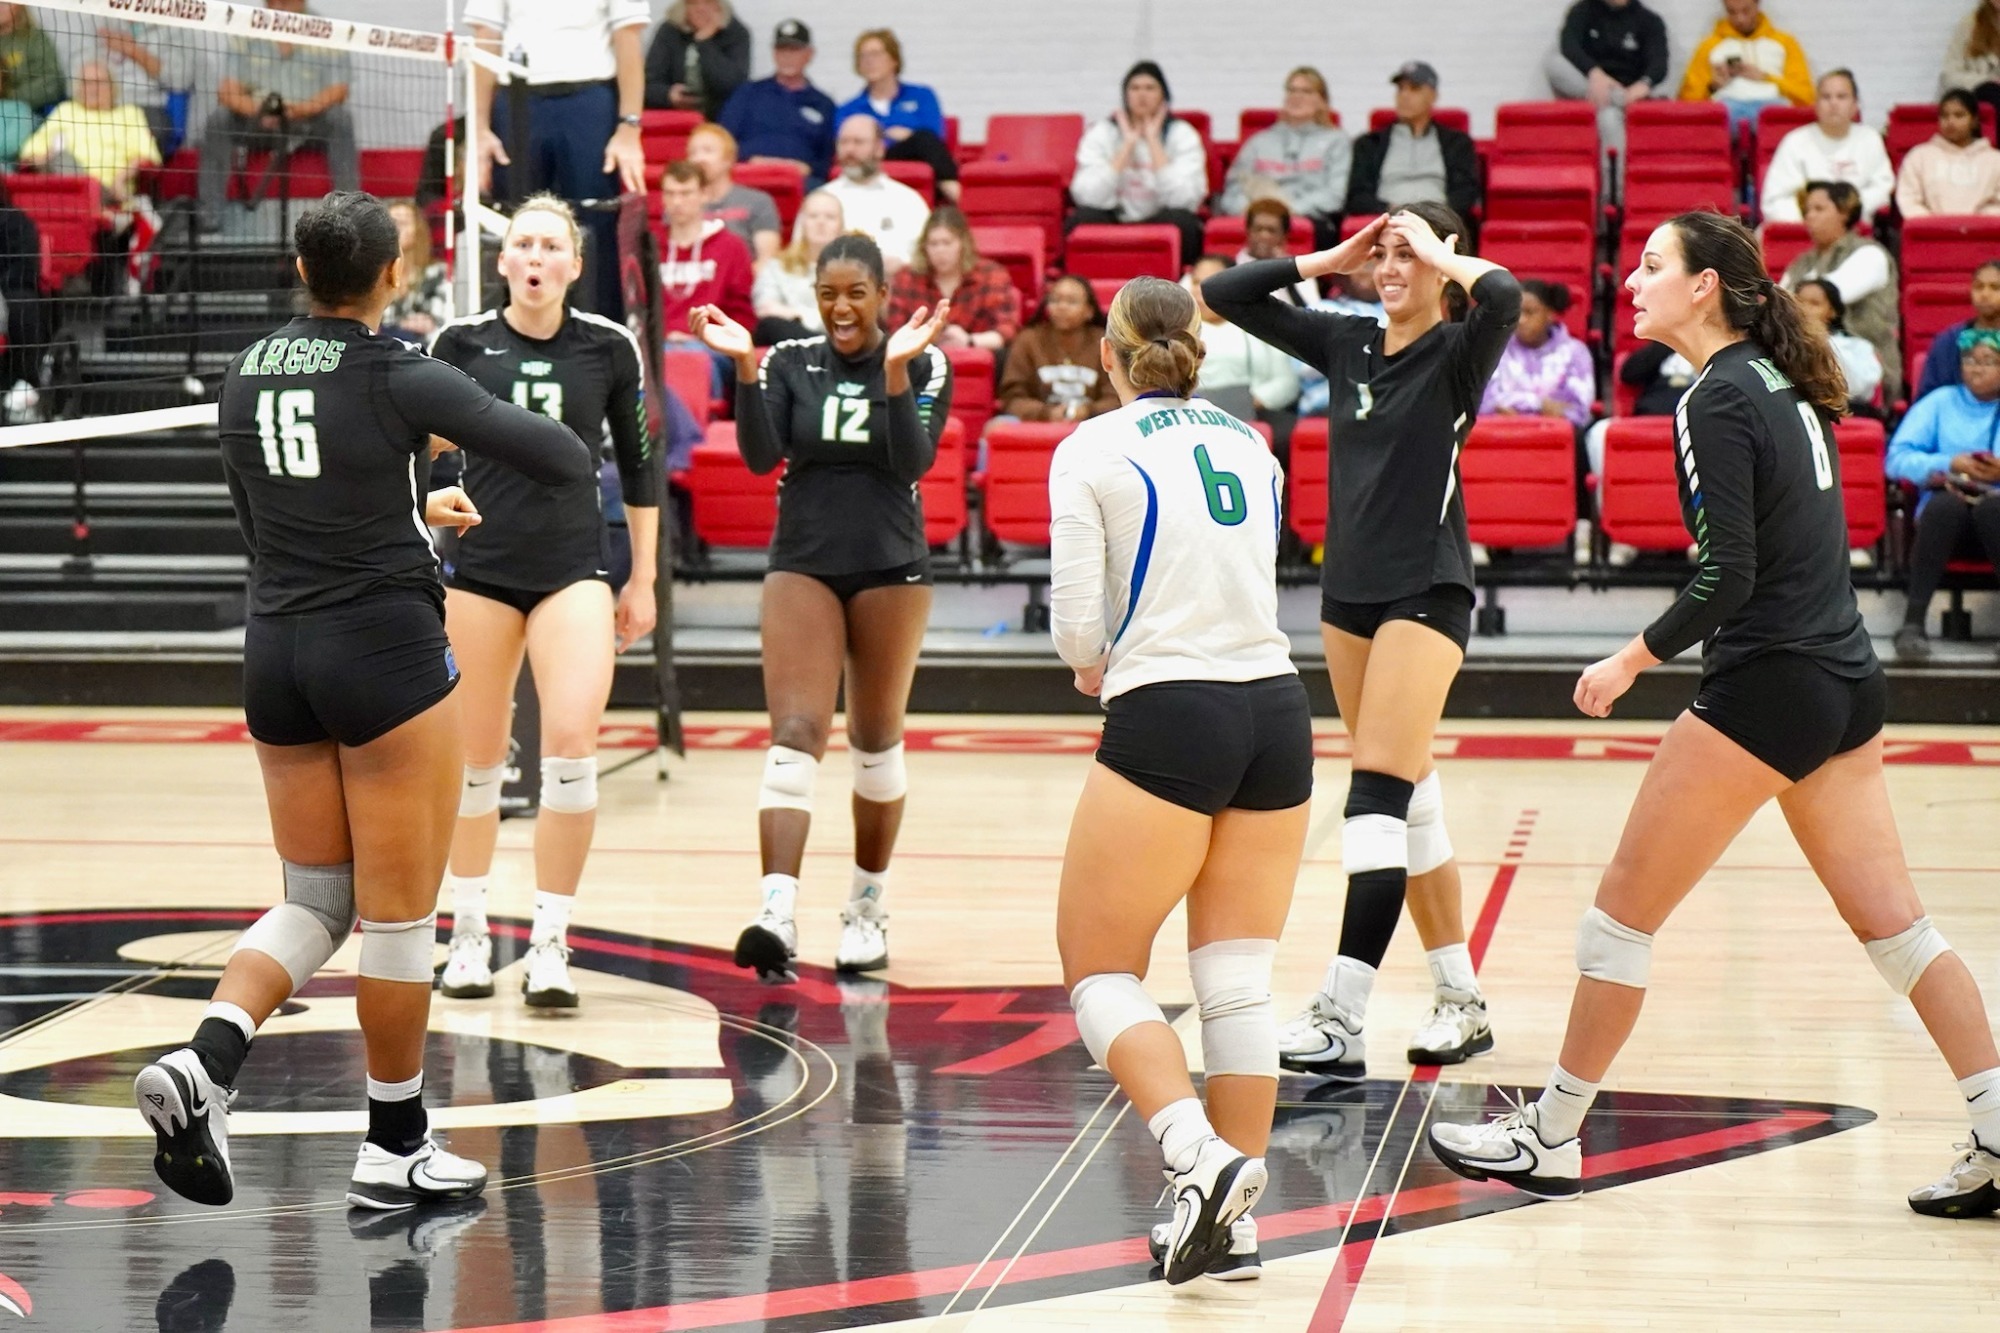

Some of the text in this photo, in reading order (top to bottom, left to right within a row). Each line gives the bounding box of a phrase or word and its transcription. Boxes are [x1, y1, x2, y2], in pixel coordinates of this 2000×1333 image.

[239, 337, 347, 376] ARGOS
[255, 388, 322, 478] 16
[821, 394, 871, 443] 12
[1135, 408, 1181, 438] WEST
[1796, 401, 1834, 491] 8
[1193, 443, 1248, 526] 6
